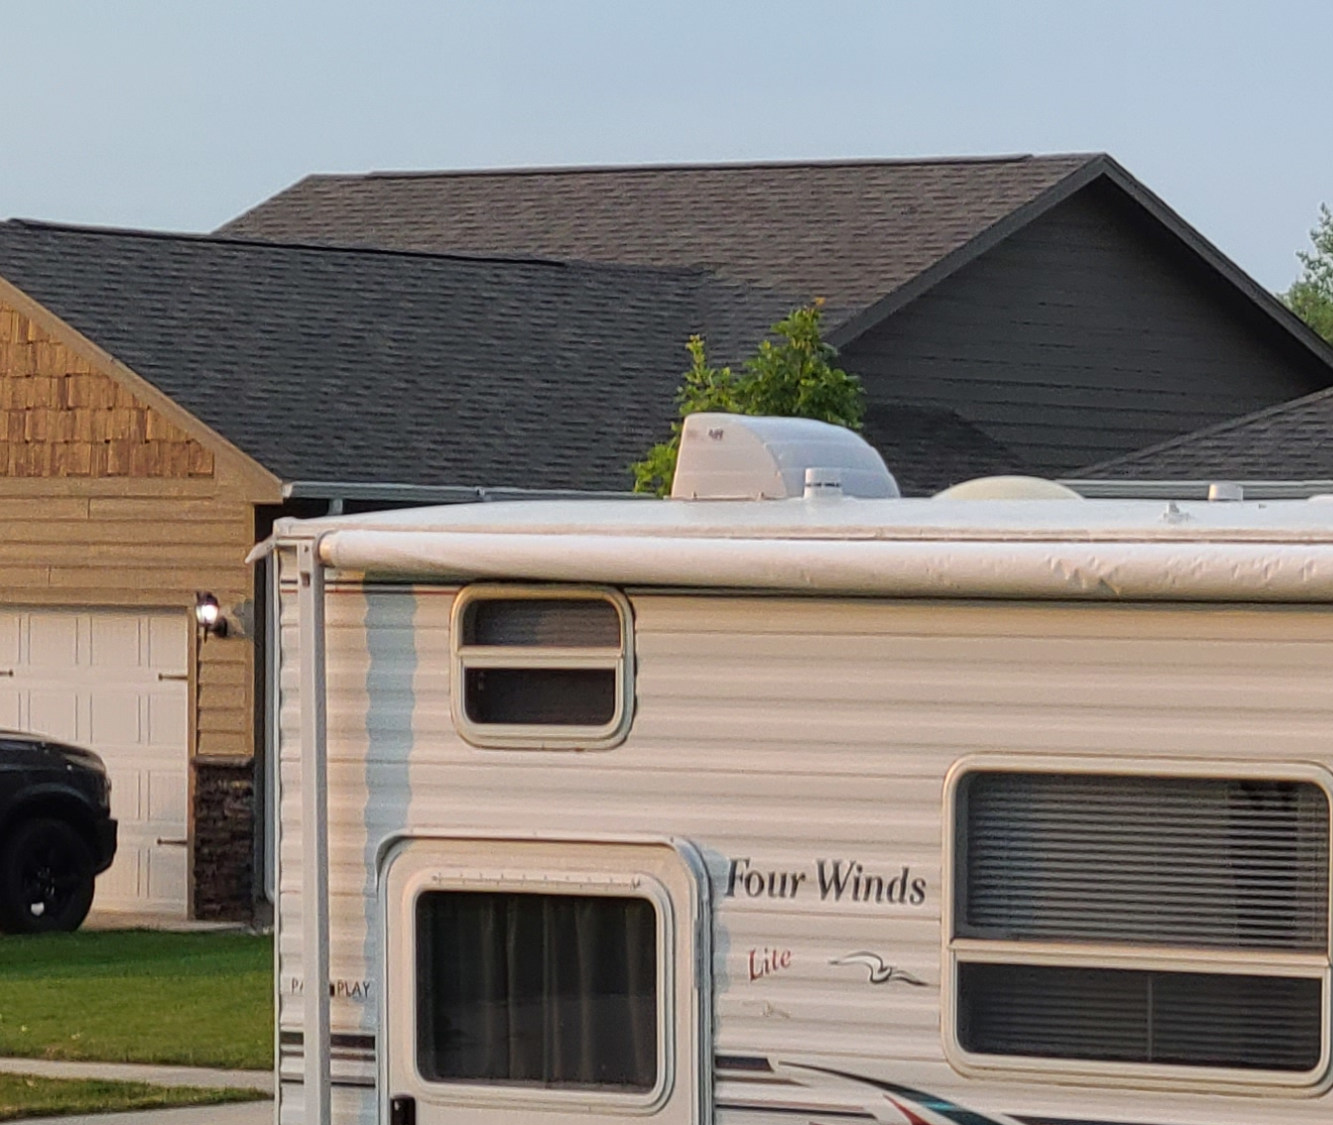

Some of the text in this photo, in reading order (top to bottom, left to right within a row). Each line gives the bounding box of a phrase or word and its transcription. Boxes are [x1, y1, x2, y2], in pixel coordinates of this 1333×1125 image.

[725, 857, 927, 905] Four Winds
[748, 948, 792, 982] Lite
[336, 979, 370, 998] PLAY
